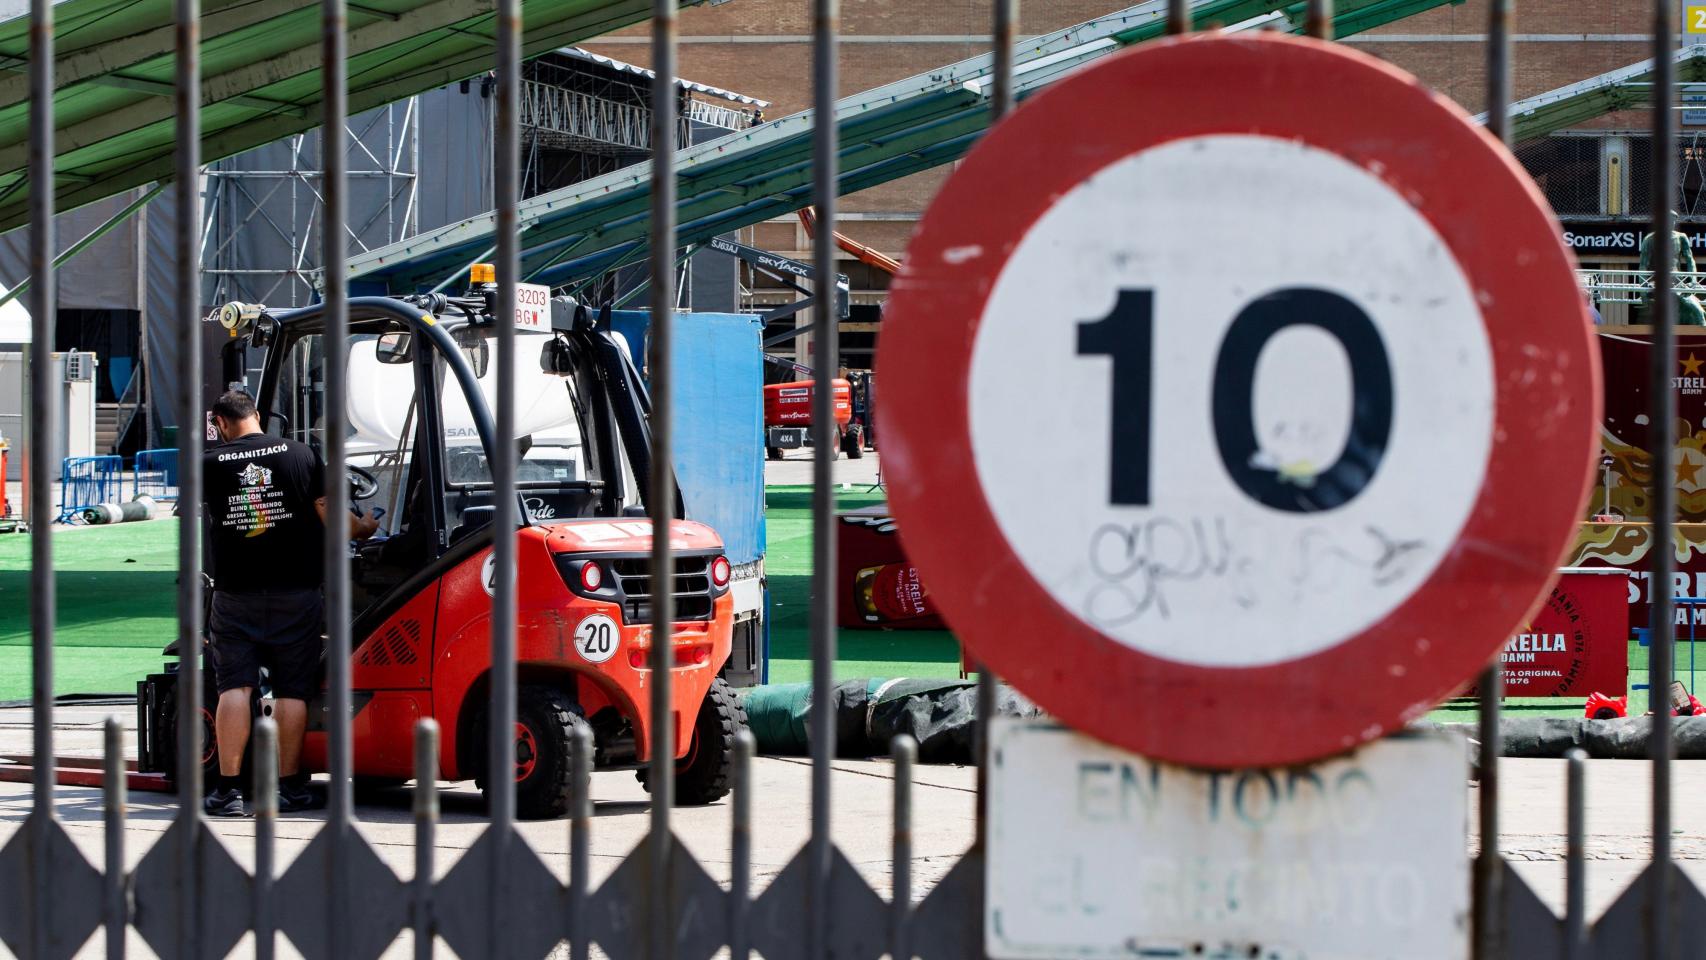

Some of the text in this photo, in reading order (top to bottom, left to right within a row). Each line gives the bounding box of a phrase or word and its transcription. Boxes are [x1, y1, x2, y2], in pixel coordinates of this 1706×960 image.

[711, 239, 740, 254] SJ63AJ
[1562, 231, 1636, 248] SonarXS
[758, 255, 808, 277] SKYJACK
[518, 288, 546, 306] 3203
[1073, 285, 1395, 515] 10
[447, 427, 479, 437] SAN
[780, 435, 794, 443] 4X4
[218, 443, 288, 462] ORGANITZACIÓ
[228, 493, 262, 503] LYRICSON
[249, 502, 282, 510] REVERENDO
[261, 507, 286, 515] WIRELESS
[909, 567, 925, 614] ESTRELLA
[584, 623, 611, 654] 20
[1503, 633, 1567, 652] RELLA
[1500, 653, 1535, 662] DAMM
[1077, 761, 1378, 836] EN TODO
